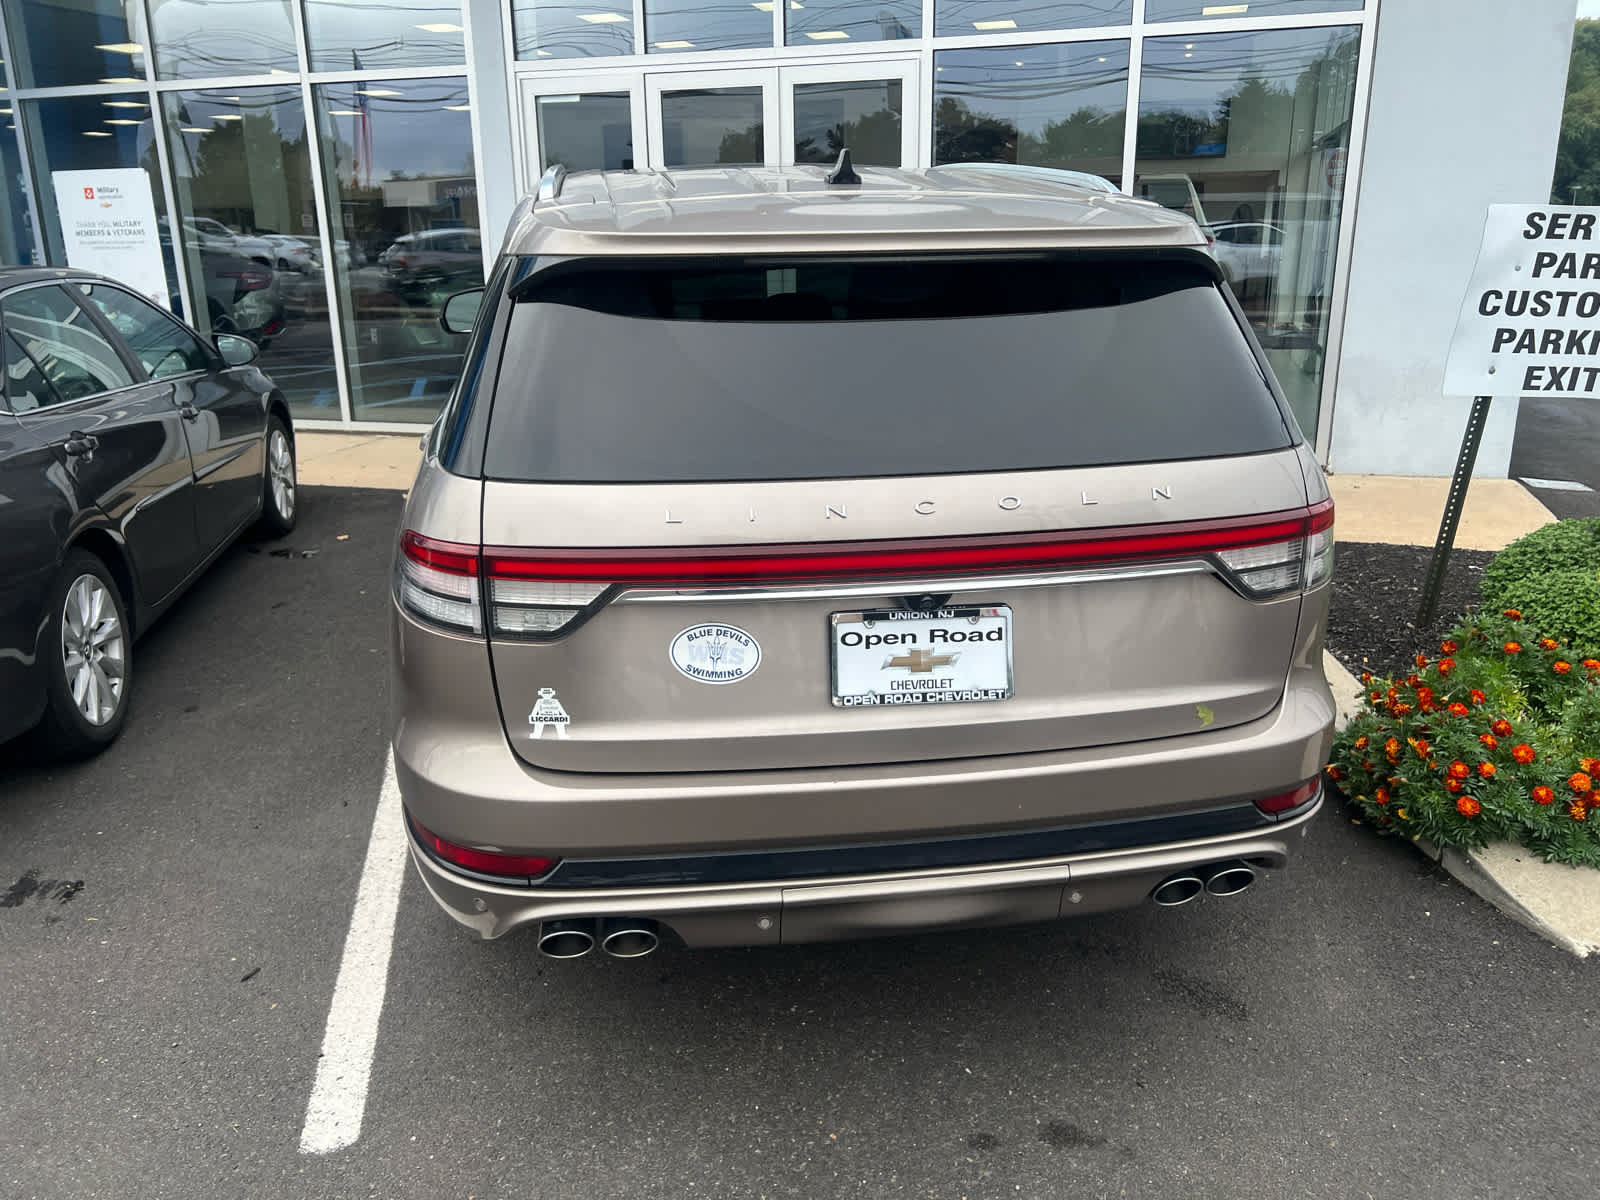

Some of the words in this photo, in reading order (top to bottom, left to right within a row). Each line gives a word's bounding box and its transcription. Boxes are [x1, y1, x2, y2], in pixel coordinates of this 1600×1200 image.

[75, 229, 106, 237] MEMBERS
[112, 228, 146, 237] VETERANS
[112, 220, 141, 228] MILITARY
[1523, 212, 1597, 240] SER
[1532, 252, 1600, 280] PAR
[1478, 290, 1600, 318] CUSTO
[1522, 366, 1600, 392] EXIT
[664, 485, 1172, 525] LINCOLN
[938, 609, 955, 619] NJ
[687, 628, 713, 642] BLUE
[716, 628, 750, 647] DEVILS
[840, 632, 917, 649] Open
[929, 627, 1003, 643] Road
[685, 664, 743, 679] SWIMMING
[890, 678, 954, 691] CHEVROLET
[843, 695, 881, 707] OPEN
[884, 692, 923, 705] ROAD
[930, 689, 1005, 702] CHEVROLET
